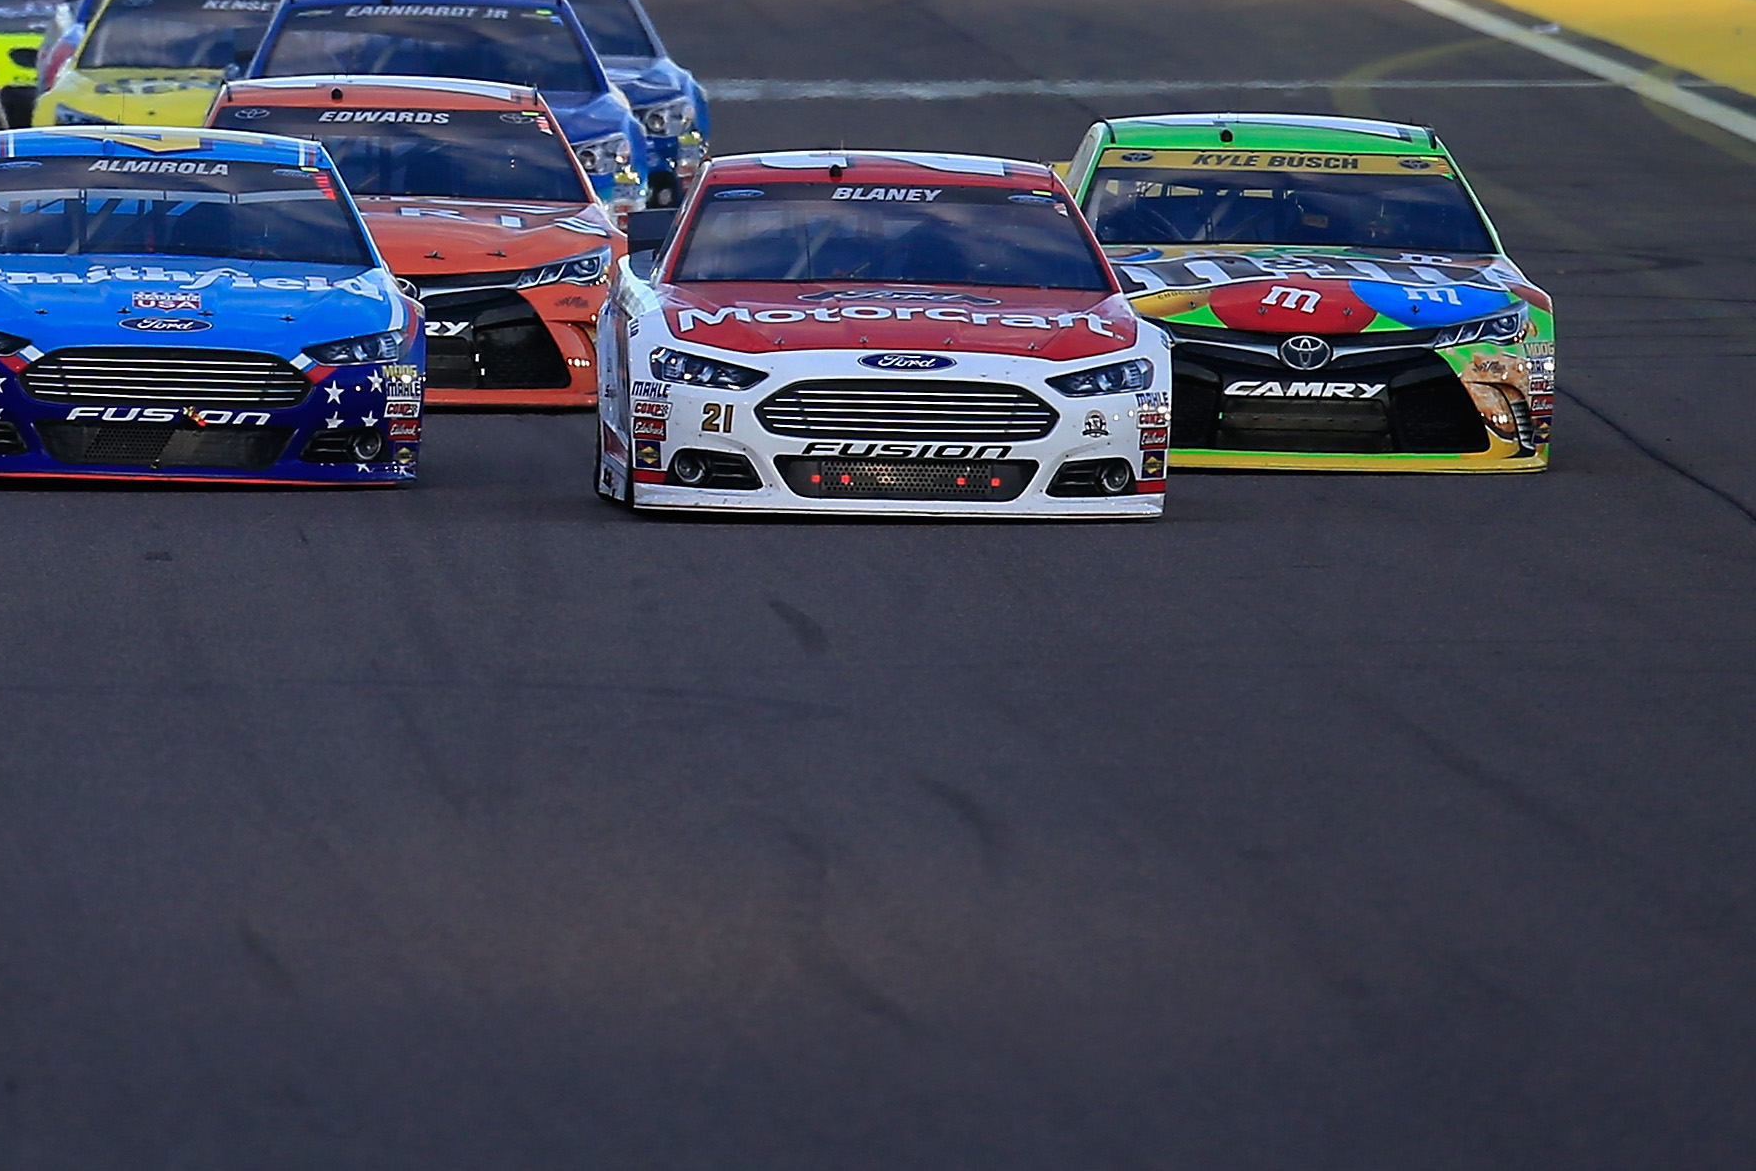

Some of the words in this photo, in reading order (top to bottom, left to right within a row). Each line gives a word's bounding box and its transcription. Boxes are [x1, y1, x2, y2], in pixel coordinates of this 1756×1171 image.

[346, 5, 478, 18] EARNHARDT
[483, 9, 509, 20] JR
[319, 110, 450, 125] EDWARDS
[88, 159, 229, 176] ALMIROLA
[1192, 154, 1260, 168] KYLE
[1267, 156, 1359, 170] BUSCH
[831, 187, 943, 203] BLANEY
[137, 299, 200, 309] USA
[137, 318, 194, 330] Ford
[677, 305, 1119, 339] Motorcraft
[878, 355, 936, 369] Ford
[632, 381, 672, 398] MAHLE
[1223, 380, 1387, 399] CAMRY
[66, 406, 272, 426] FUSON
[701, 402, 735, 434] 21
[801, 442, 1014, 460] FUSION
